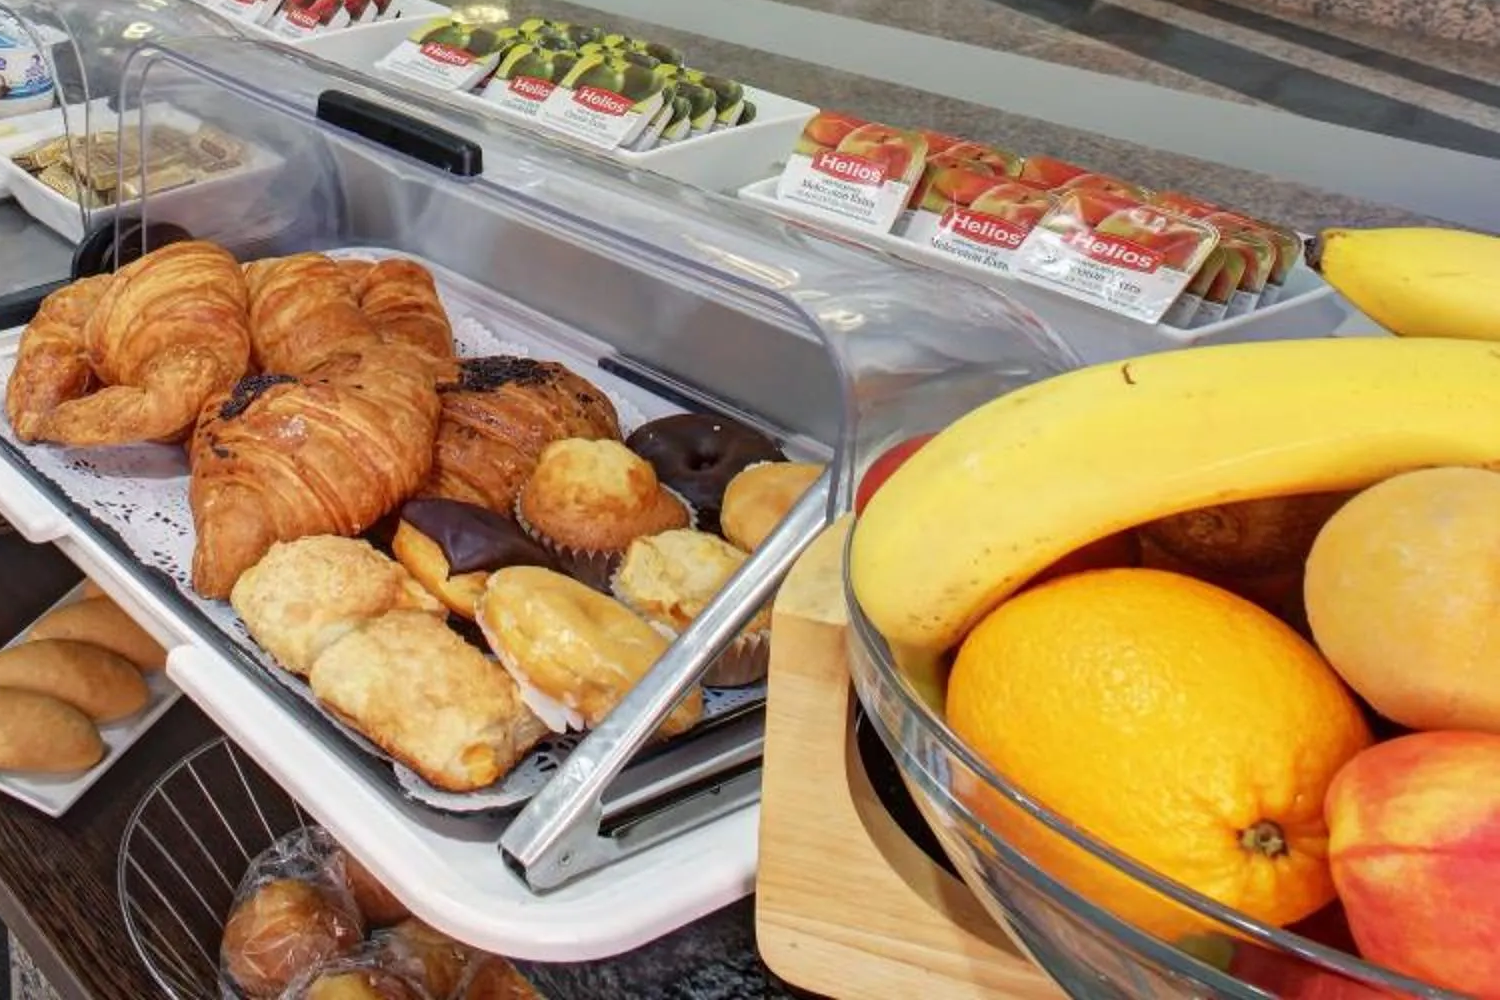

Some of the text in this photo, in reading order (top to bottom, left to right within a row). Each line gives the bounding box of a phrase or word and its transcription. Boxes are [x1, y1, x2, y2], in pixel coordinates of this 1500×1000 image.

[513, 79, 550, 97] Helio
[579, 88, 629, 114] Helios
[819, 153, 885, 183] Helios
[950, 211, 1025, 246] Helios
[1071, 230, 1155, 269] Helios
